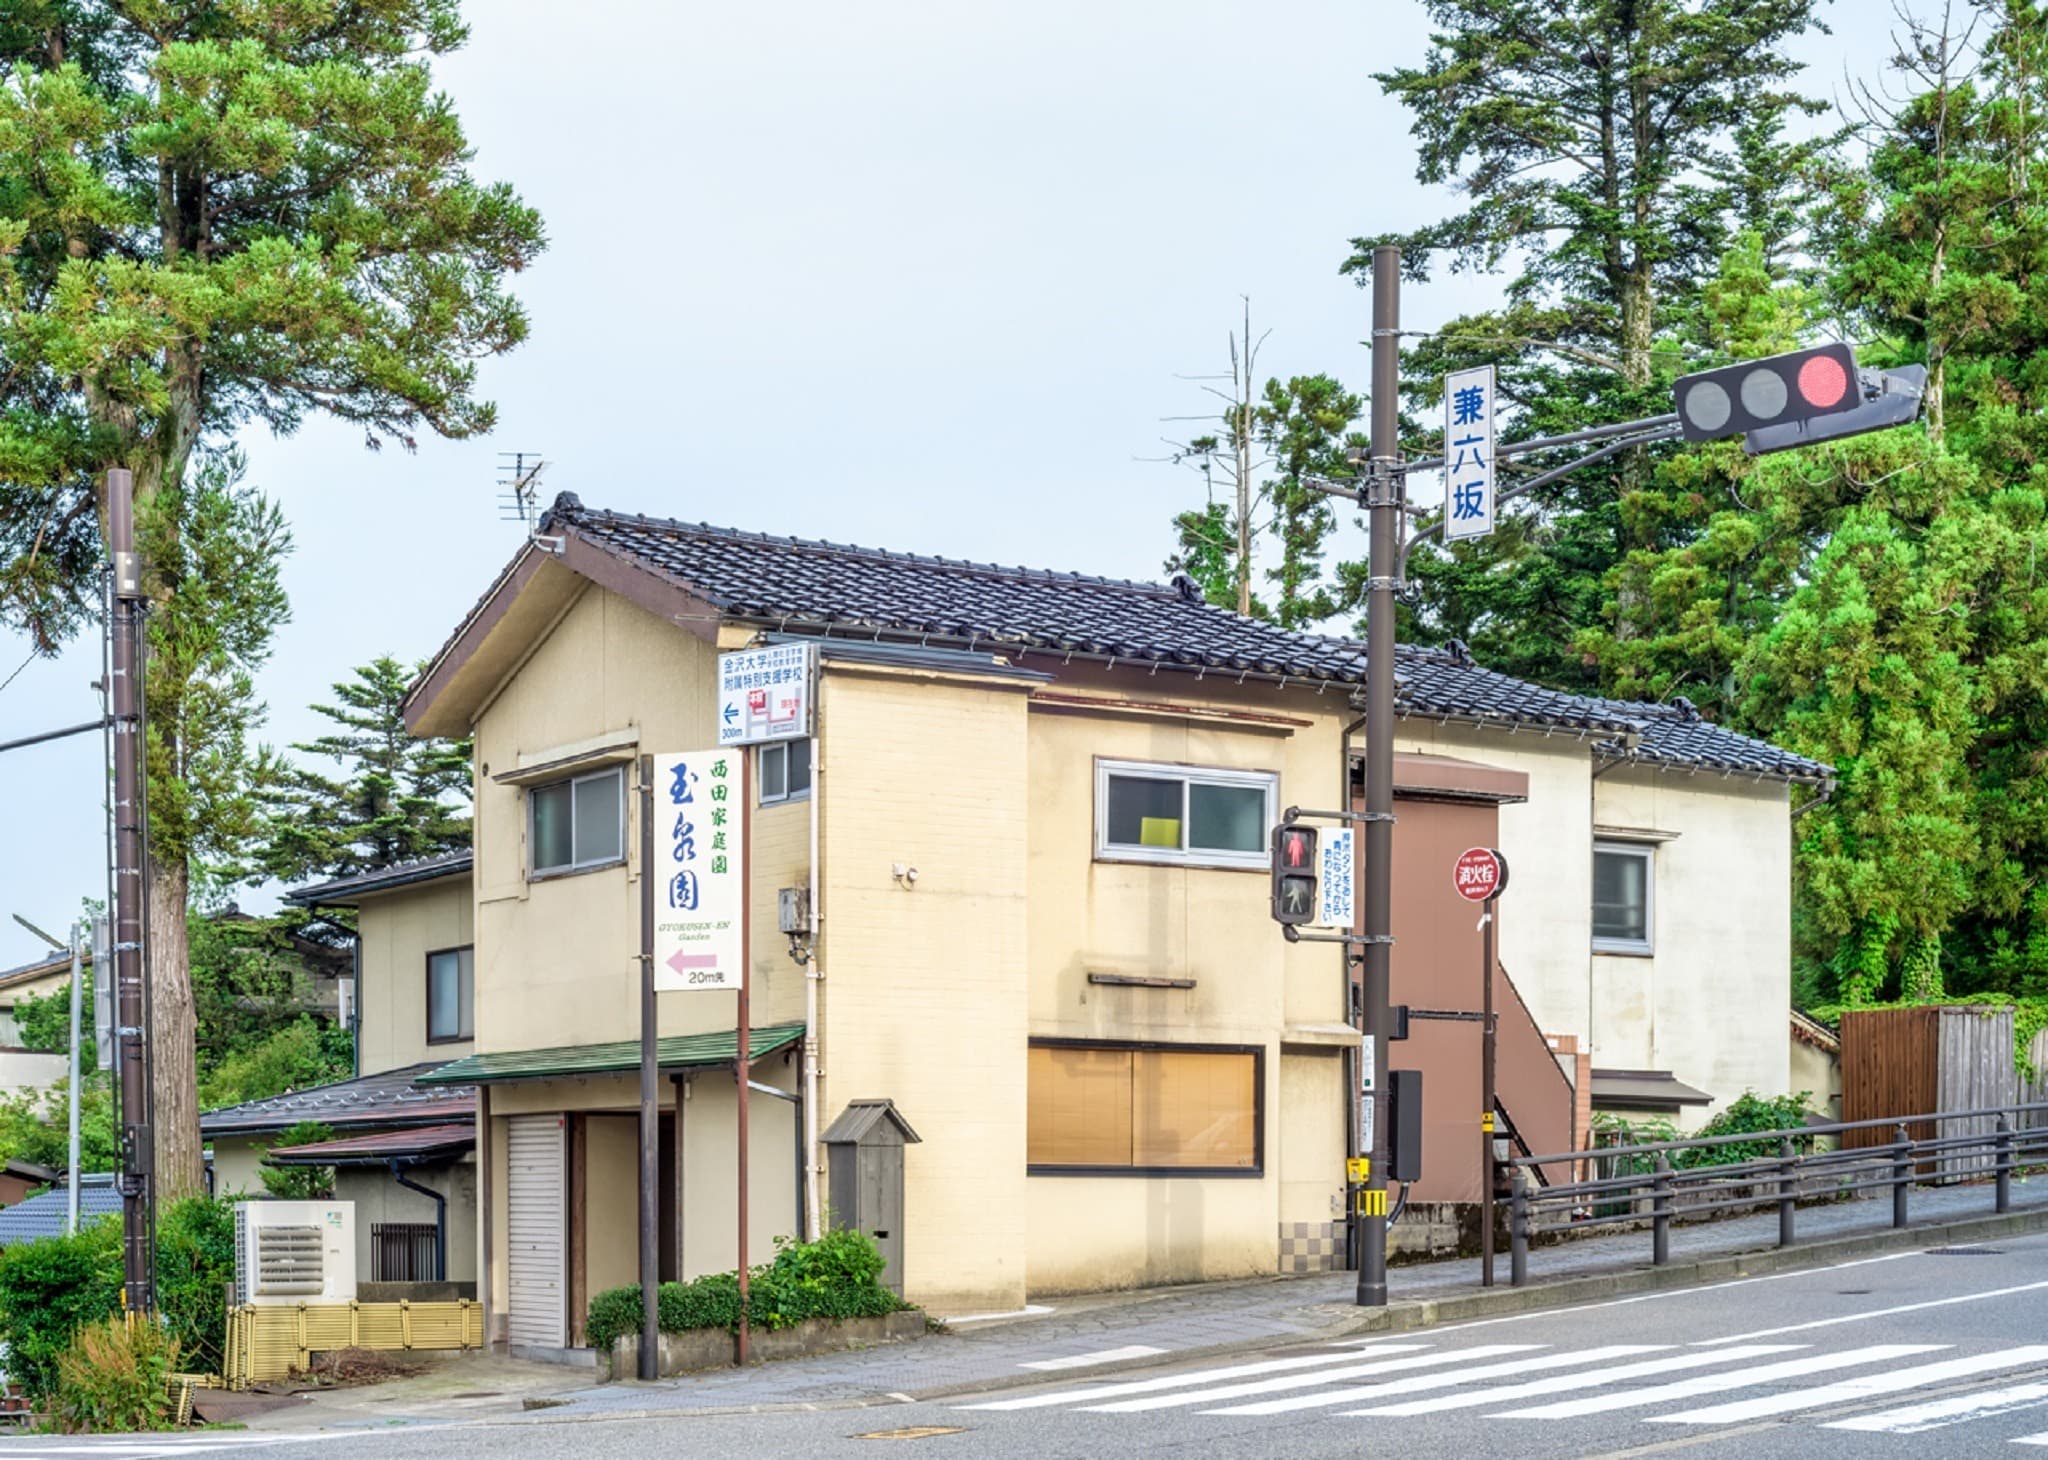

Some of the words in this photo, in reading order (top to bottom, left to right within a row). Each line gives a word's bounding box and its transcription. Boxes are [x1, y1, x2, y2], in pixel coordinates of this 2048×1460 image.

[1453, 385, 1486, 520] 兼六坂
[724, 655, 767, 674] 金沢大学
[724, 666, 802, 691] 附属特別支援学校
[710, 759, 729, 875] 西田家庭園
[669, 762, 699, 911] 玉泉園
[1459, 864, 1494, 884] 消火栓
[678, 933, 711, 941] Garden
[689, 971, 725, 984] 20m先
